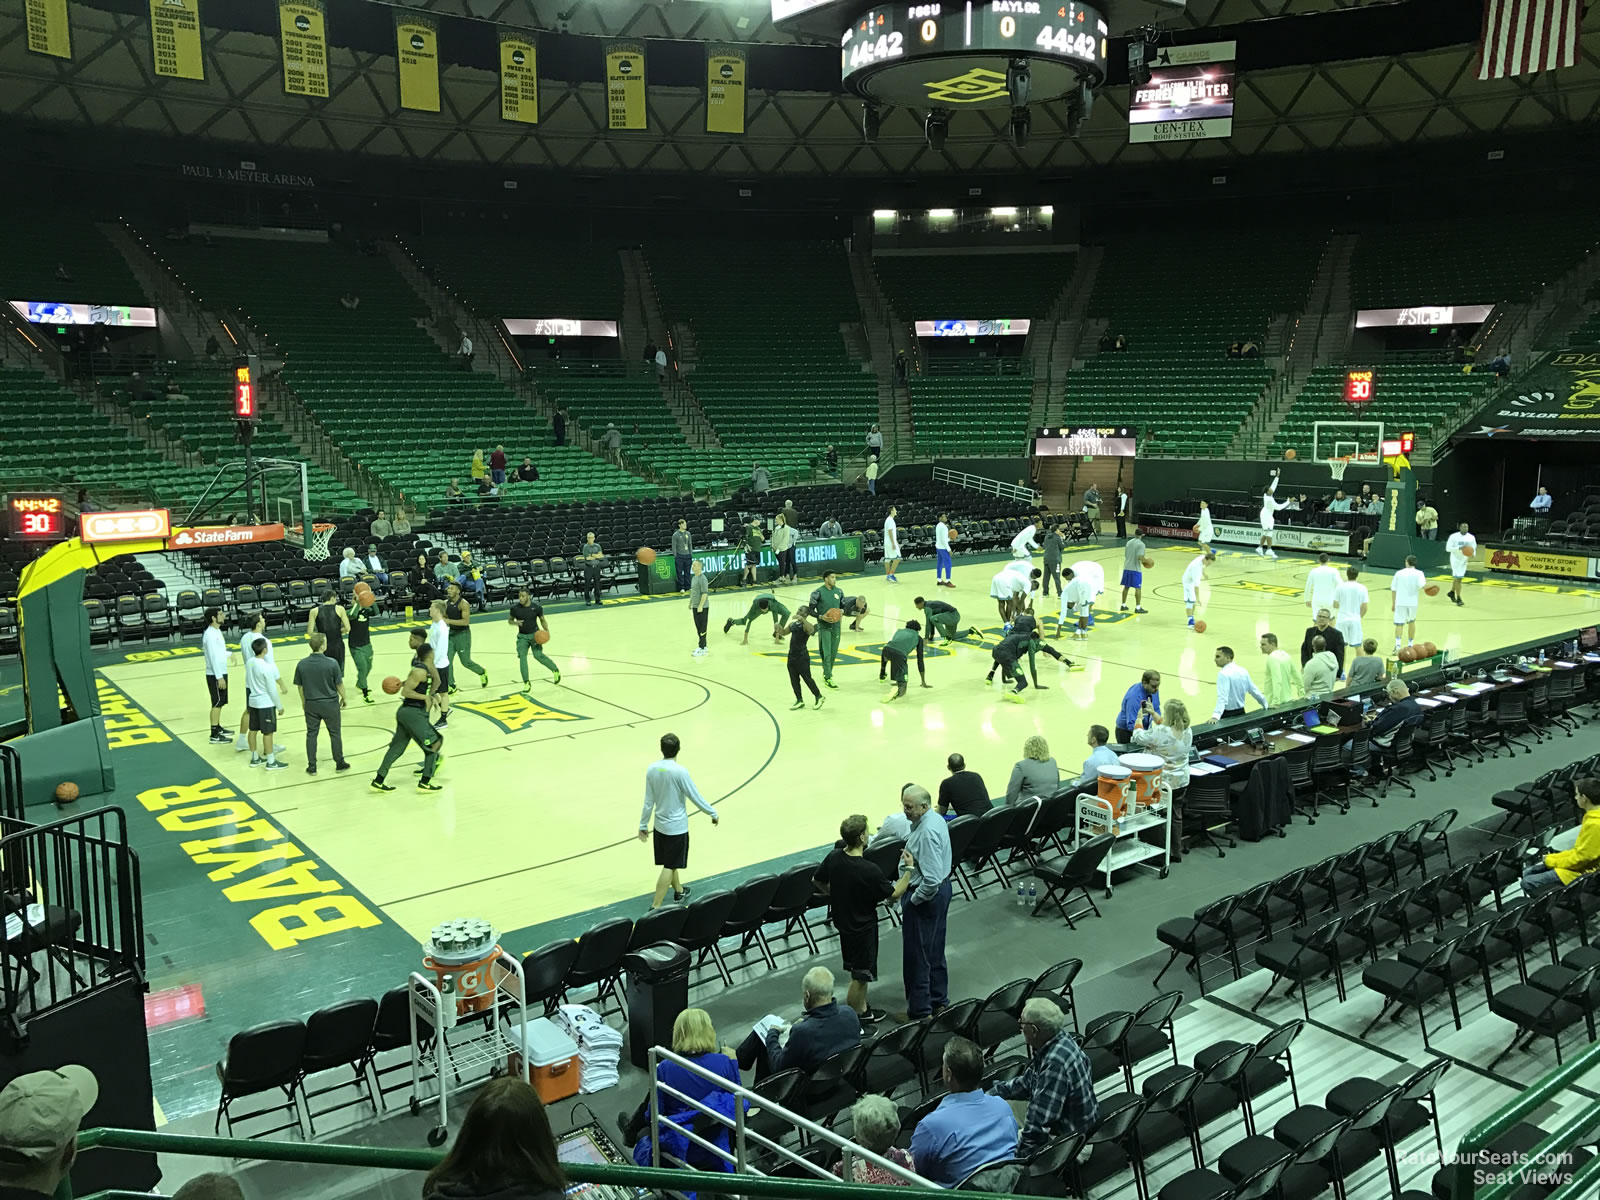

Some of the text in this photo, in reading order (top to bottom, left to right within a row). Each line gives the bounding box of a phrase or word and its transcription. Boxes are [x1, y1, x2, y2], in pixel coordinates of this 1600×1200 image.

[992, 0, 1040, 14] BAYLOR
[1058, 7, 1066, 18] 4
[876, 14, 885, 25] 4
[1077, 11, 1085, 22] 4
[860, 20, 868, 31] 4
[921, 20, 937, 41] 0
[1001, 16, 1016, 37] 0
[156, 35, 175, 43] 2011
[285, 39, 302, 47] 2001
[1036, 25, 1096, 60] 44:42
[850, 31, 903, 68] 44:42
[1176, 50, 1210, 59] GRANDE
[1154, 121, 1205, 134] CEN-TEX
[1174, 131, 1206, 139] SYSTEMS
[182, 164, 213, 177] PAUL
[228, 170, 271, 183] MEYER
[273, 174, 315, 187] ARENA
[1396, 306, 1453, 325] #SICEM
[535, 319, 581, 335] #SICEM
[1352, 382, 1370, 398] 30
[1497, 410, 1559, 419] BAYLOR
[1057, 446, 1113, 455] BASKETBALL
[14, 499, 59, 512] 44:42
[25, 514, 50, 532] 30
[1160, 519, 1179, 528] Waco
[1146, 526, 1194, 537] Tribune Herald
[1276, 531, 1304, 544] CENTRAL
[809, 544, 837, 561] ARENA
[135, 777, 384, 951] BAYLOR
[461, 971, 478, 989] G
